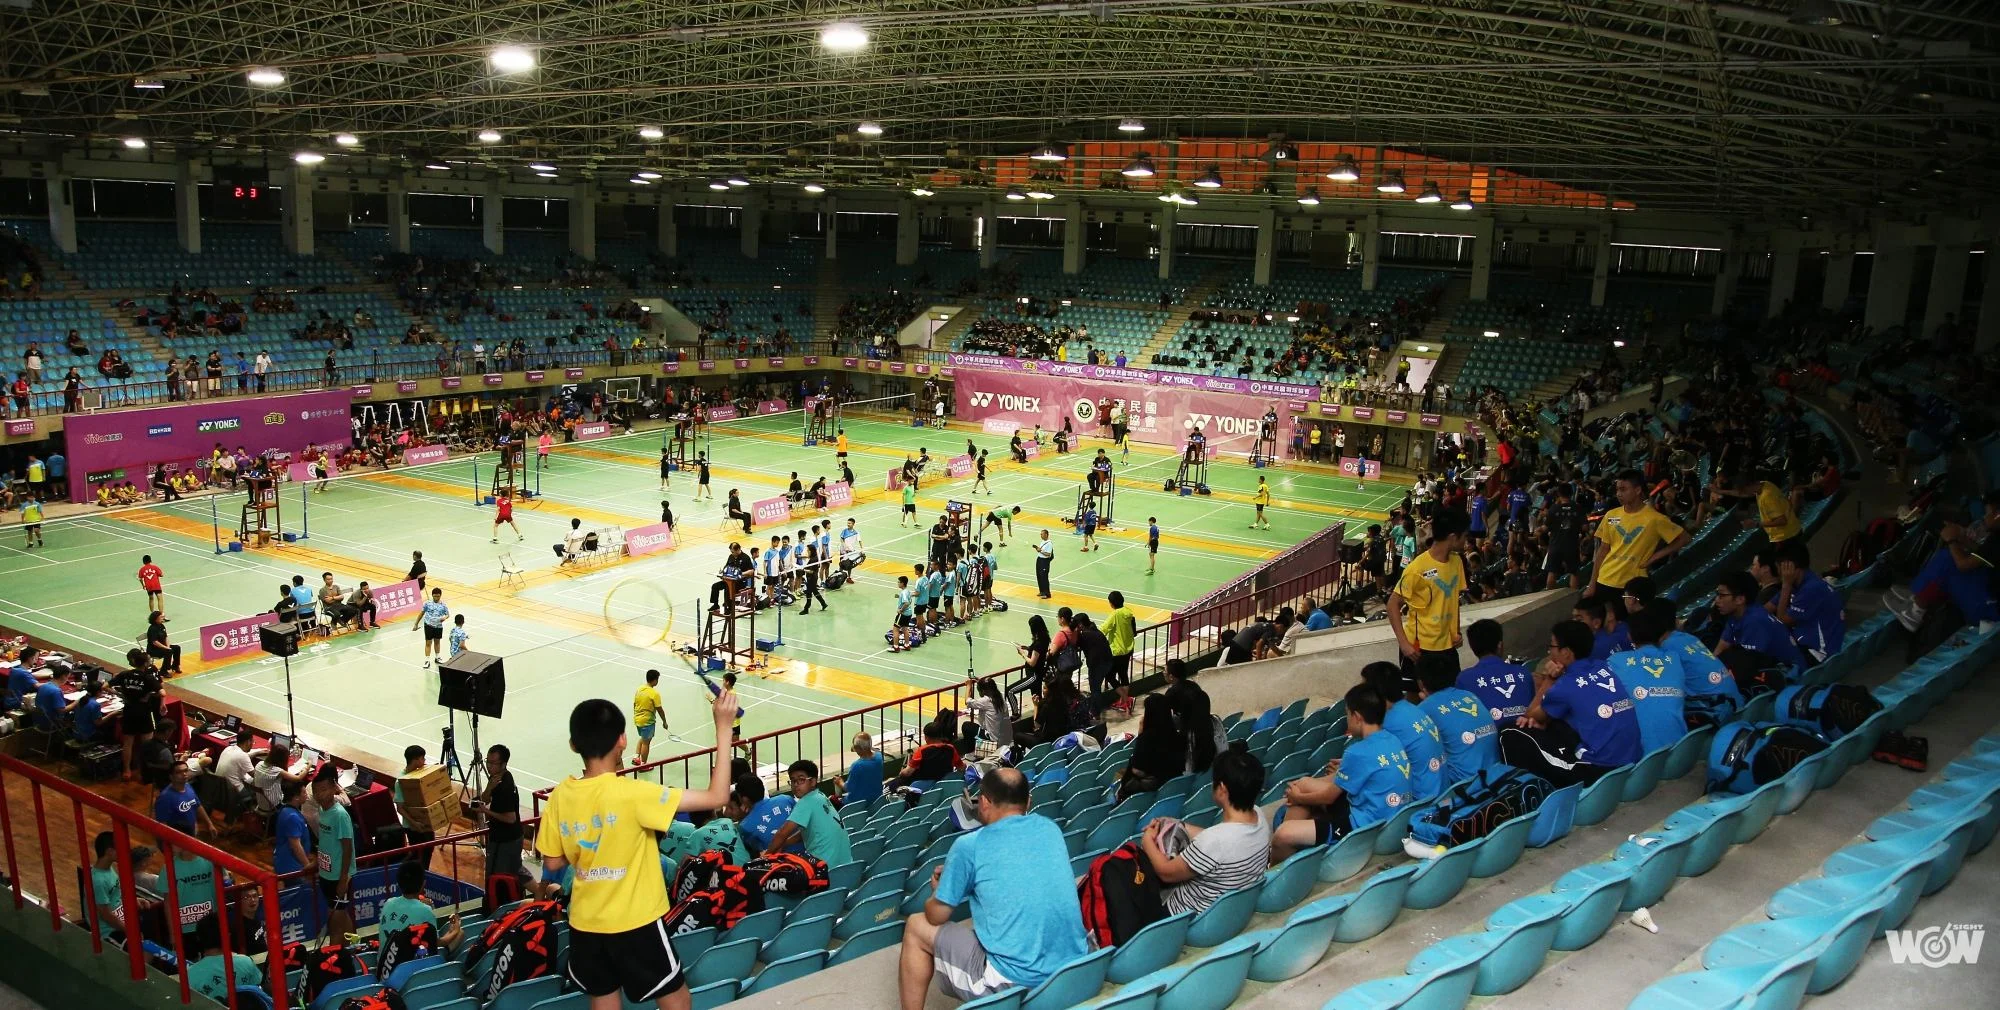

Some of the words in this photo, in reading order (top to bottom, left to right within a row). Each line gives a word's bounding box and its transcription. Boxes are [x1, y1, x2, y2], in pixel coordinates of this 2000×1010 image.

[1063, 365, 1083, 373] YONEX
[1174, 375, 1195, 385] YONEX
[997, 393, 1041, 413] YONEX
[214, 419, 239, 430] YONEX
[1215, 415, 1263, 436] YONEX
[380, 587, 413, 602] 中華民國
[229, 623, 260, 637] 中華民
[230, 633, 260, 646] 羽球協
[1477, 672, 1525, 688] 萬和國中
[762, 877, 788, 892] TOR
[380, 941, 399, 980] CTOR
